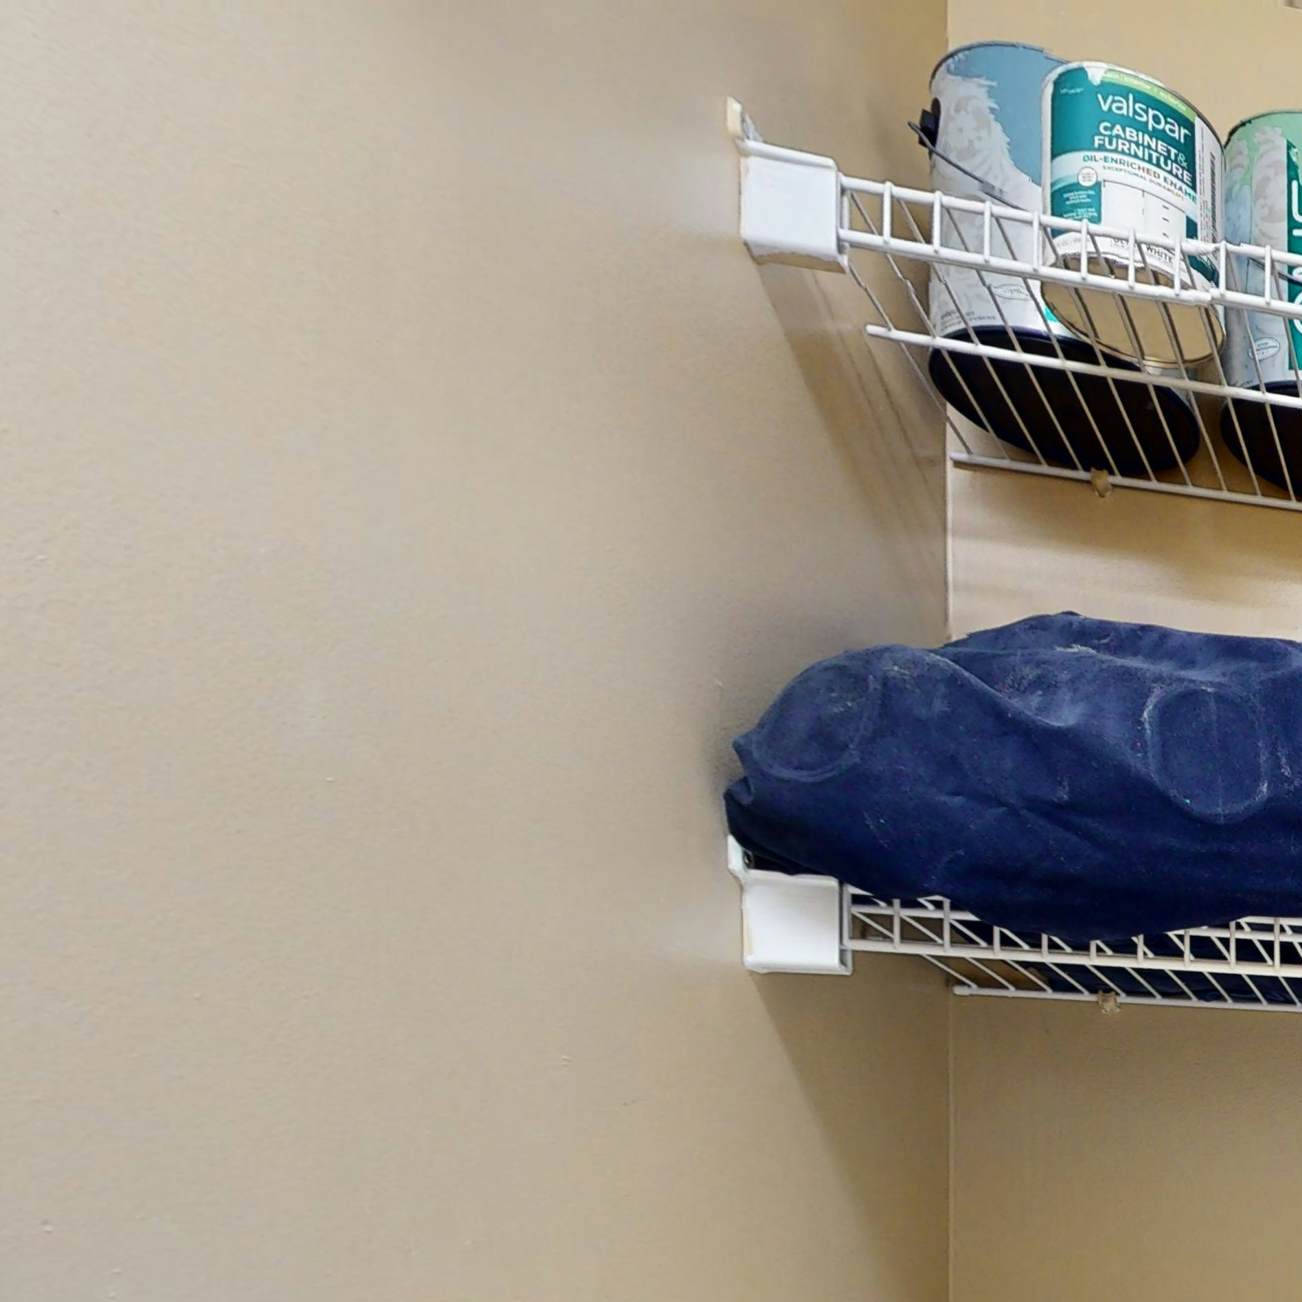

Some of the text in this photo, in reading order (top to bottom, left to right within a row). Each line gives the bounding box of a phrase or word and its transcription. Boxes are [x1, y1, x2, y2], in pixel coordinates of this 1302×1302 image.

[1097, 92, 1192, 144] valspar
[1099, 121, 1177, 161] CABINET
[1082, 154, 1161, 180] OIL-ENRICHED
[1094, 135, 1193, 187] FURNITURE
